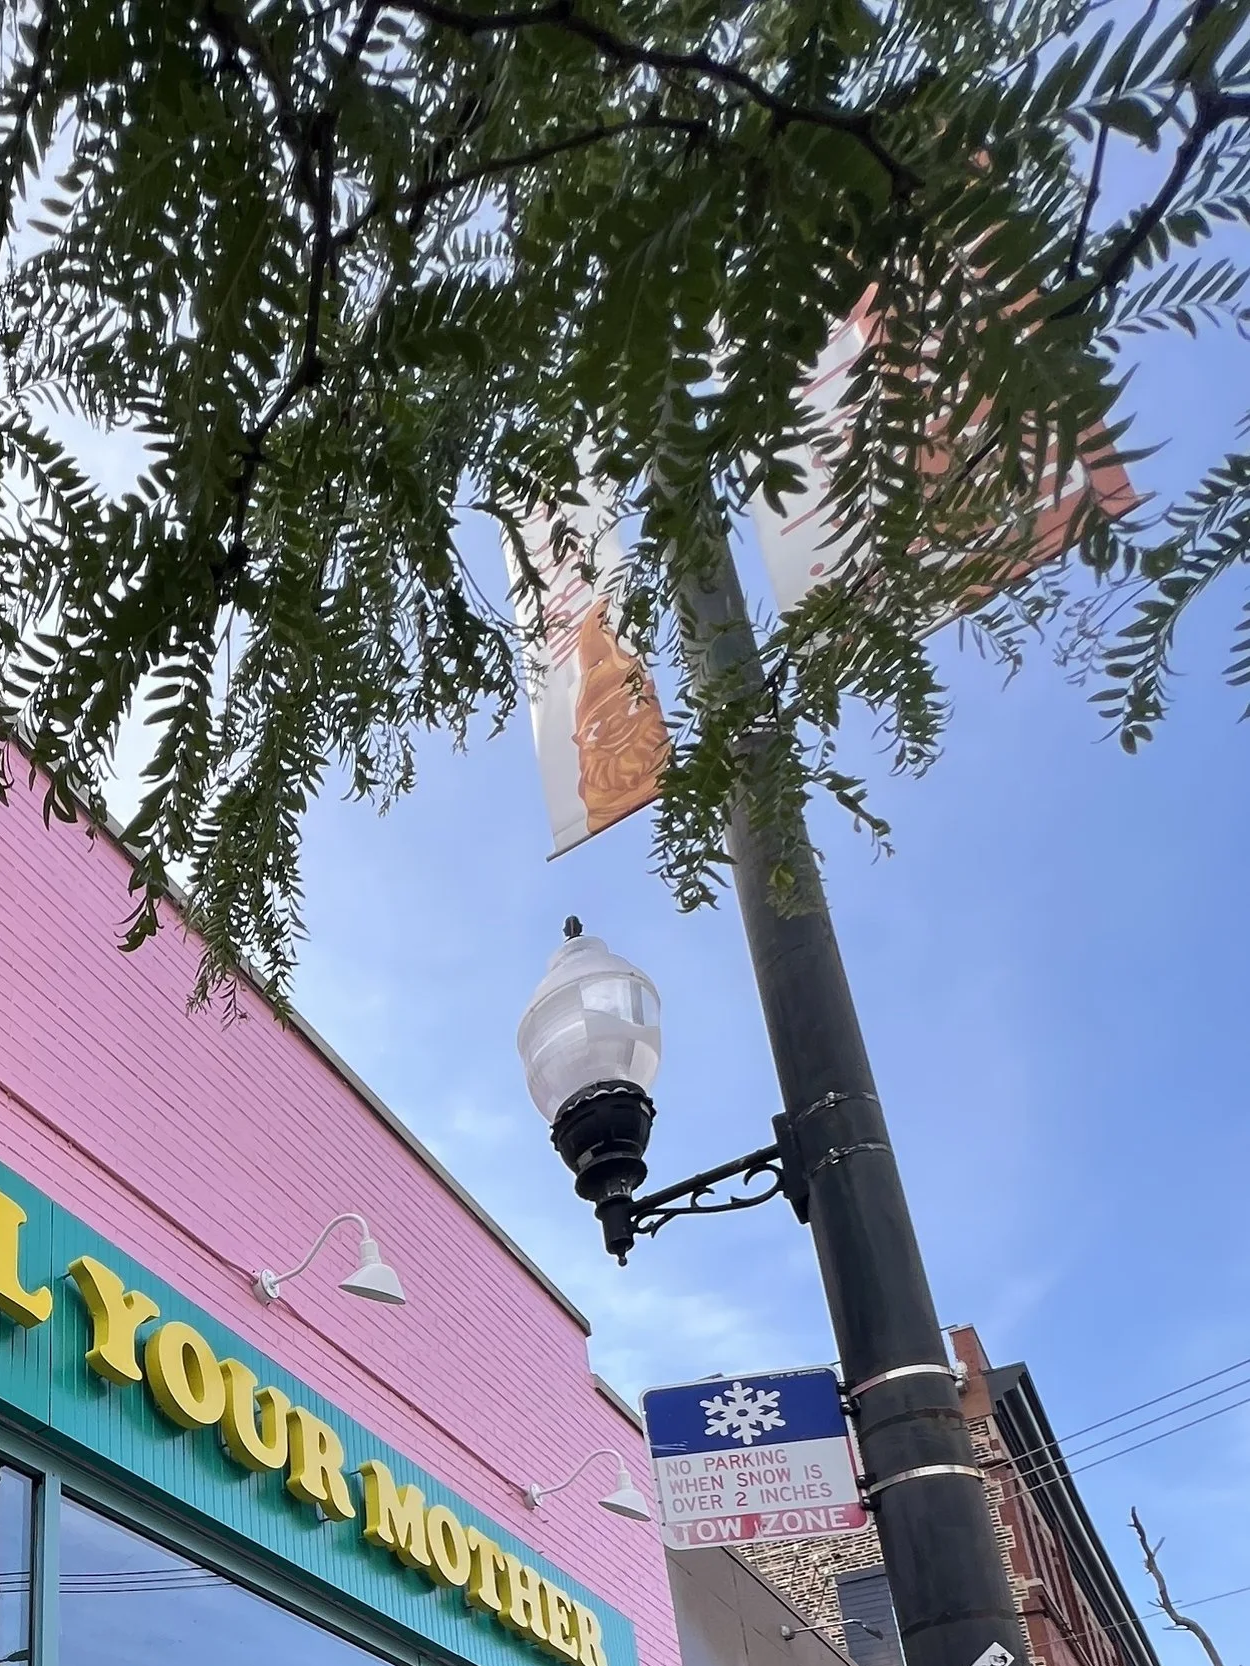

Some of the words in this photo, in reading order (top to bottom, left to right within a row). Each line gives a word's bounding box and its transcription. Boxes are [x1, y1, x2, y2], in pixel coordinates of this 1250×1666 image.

[68, 1255, 356, 1522] YOUR
[665, 1459, 692, 1477] NO
[704, 1449, 787, 1473] PARKING
[669, 1474, 724, 1496] WHEN
[736, 1467, 791, 1488] SNOW
[803, 1464, 822, 1480] IS
[672, 1494, 723, 1514] OVER
[735, 1491, 748, 1507] 2
[760, 1482, 833, 1504] INCHES
[676, 1517, 741, 1542] TOW
[762, 1506, 850, 1534] ZONE
